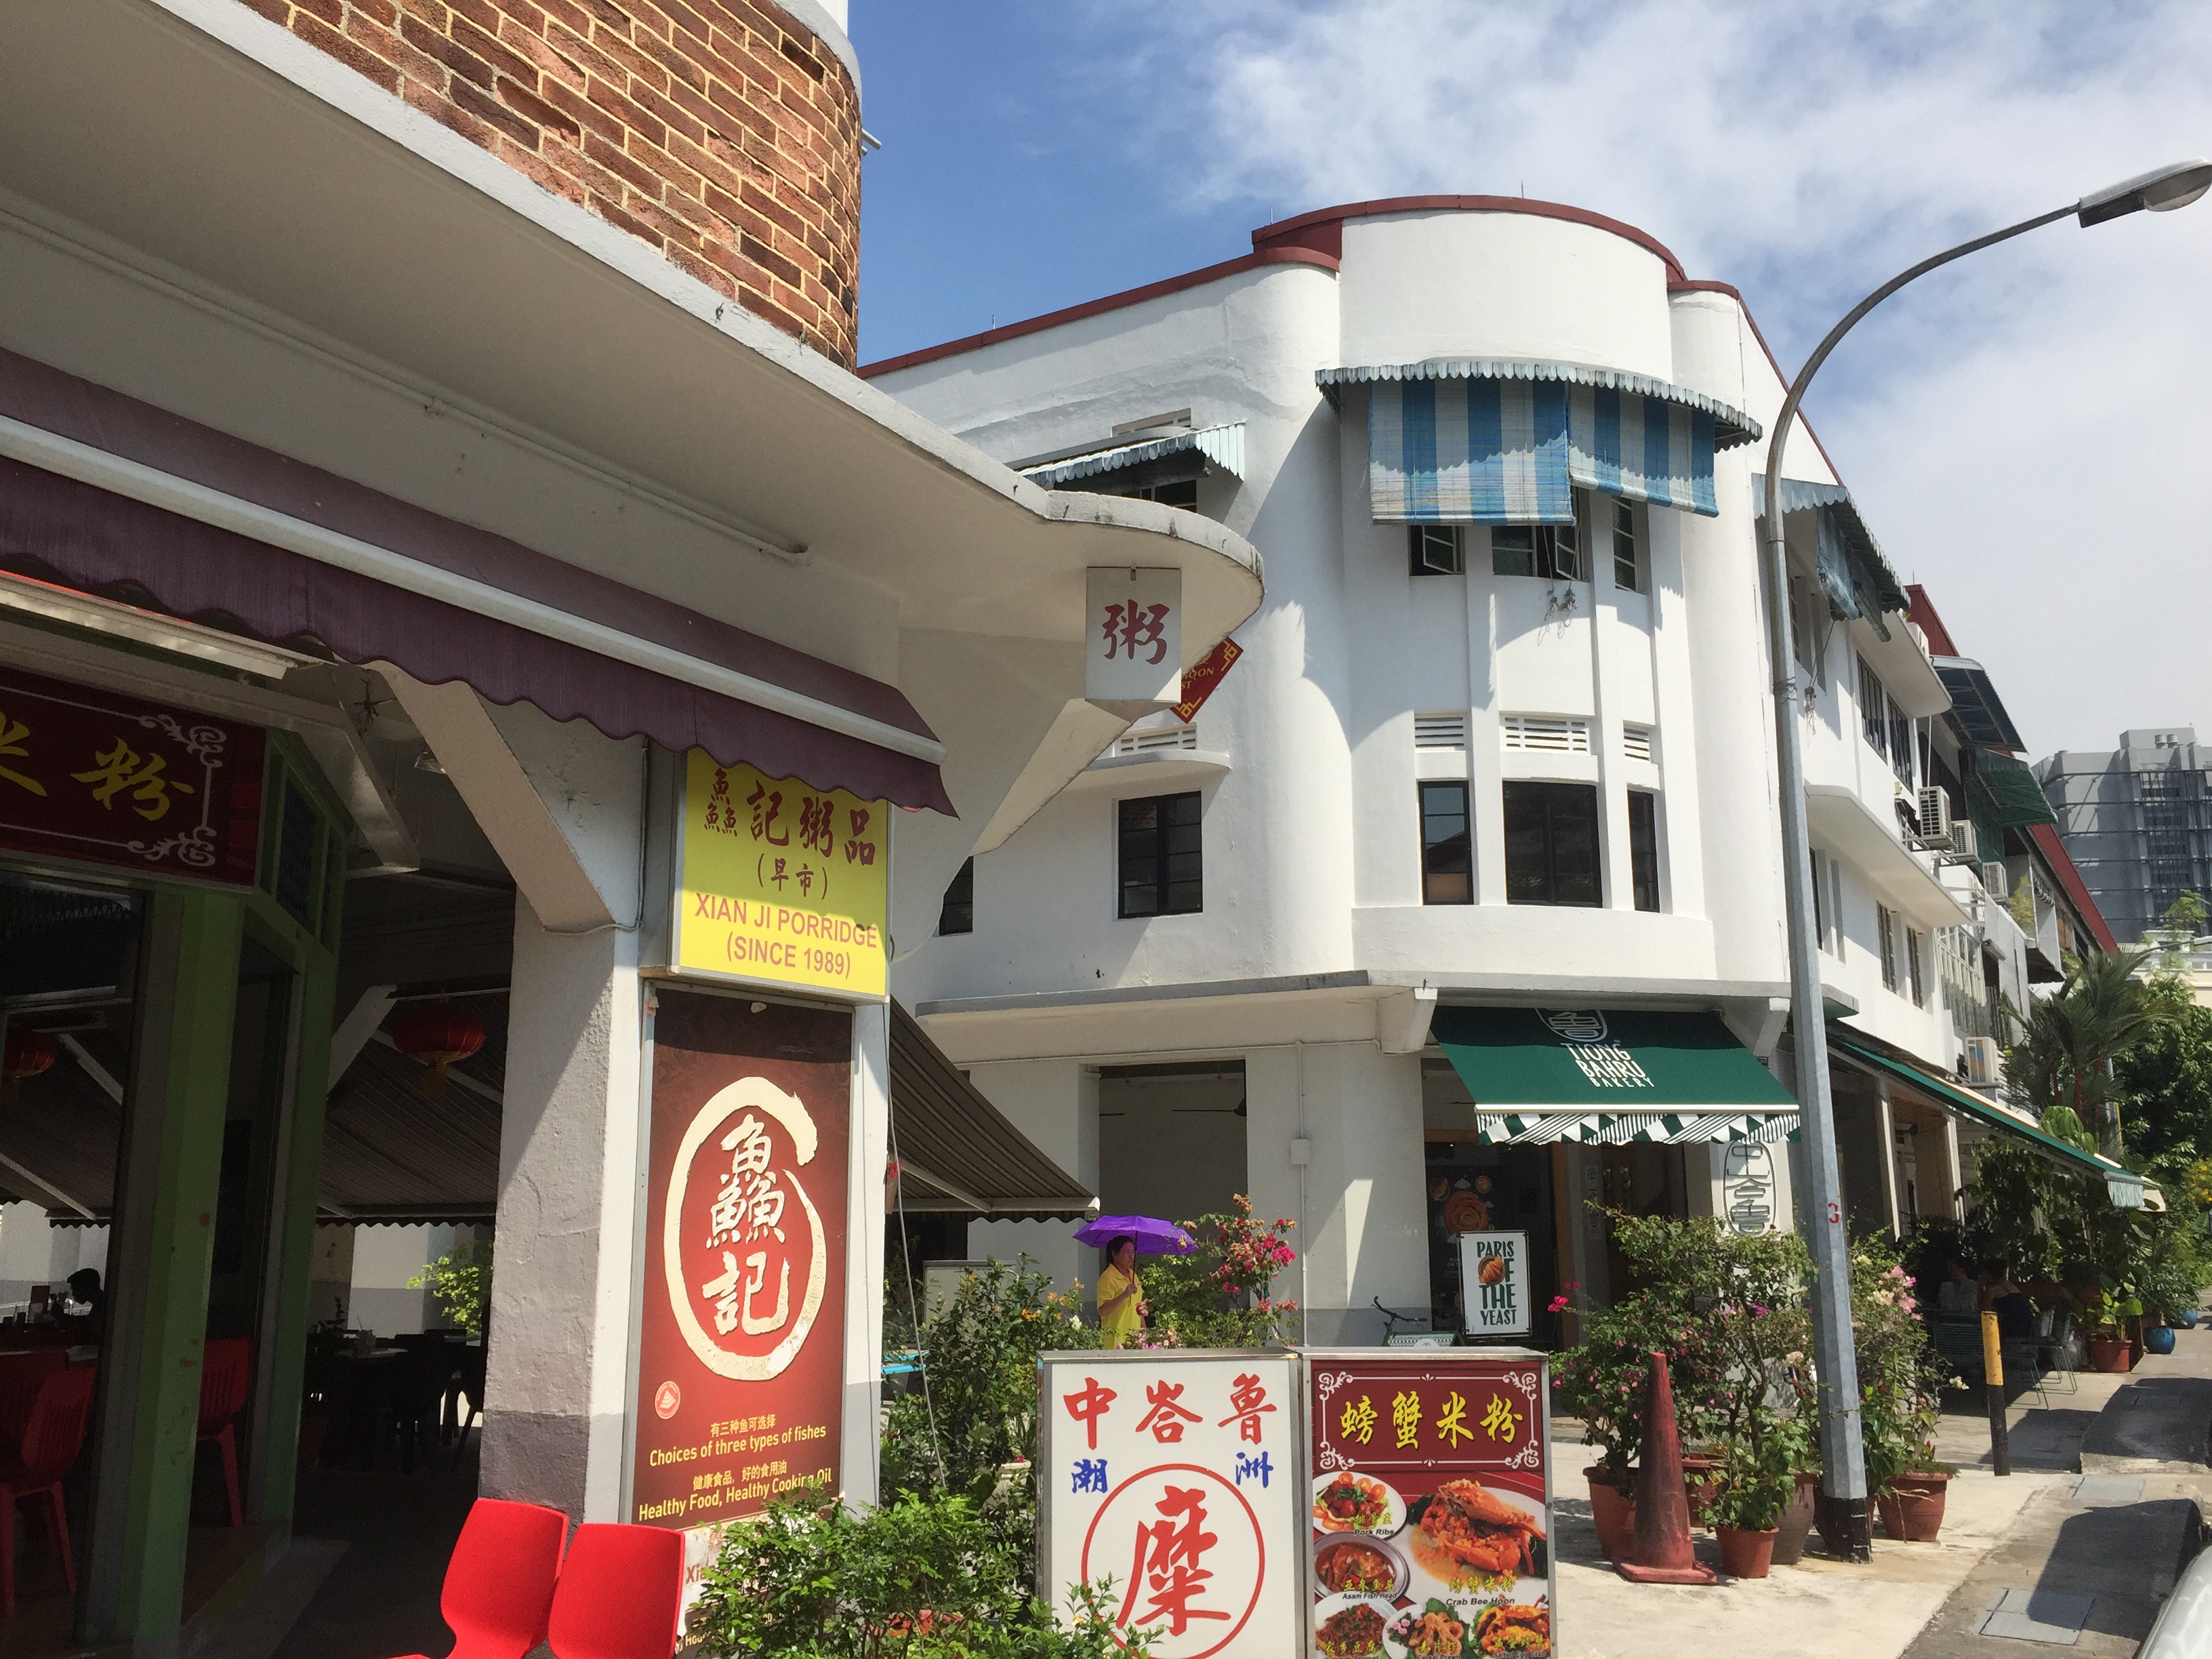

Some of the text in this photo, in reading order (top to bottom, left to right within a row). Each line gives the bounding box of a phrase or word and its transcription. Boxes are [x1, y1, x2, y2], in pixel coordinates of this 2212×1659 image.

[1102, 599, 1170, 665] 粥
[695, 893, 877, 948] XIAN JI PORRIDGE
[727, 932, 851, 980] (SINCE 1989)
[1560, 1042, 1631, 1061] TIONG
[1576, 1059, 1646, 1078] BAHRU
[1589, 1077, 1654, 1087] BAKERY
[1476, 1241, 1515, 1258] PARIS
[1479, 1284, 1517, 1309] THE
[1480, 1309, 1517, 1326] YEAST
[710, 1414, 776, 1437] 有三种鱼可选择
[1340, 1391, 1523, 1450] 螃蟹米粉
[649, 1425, 826, 1467] Choices of three types of fishes
[638, 1496, 686, 1521] Healthy
[689, 1490, 722, 1511] Food,
[726, 1481, 771, 1503] Healthy
